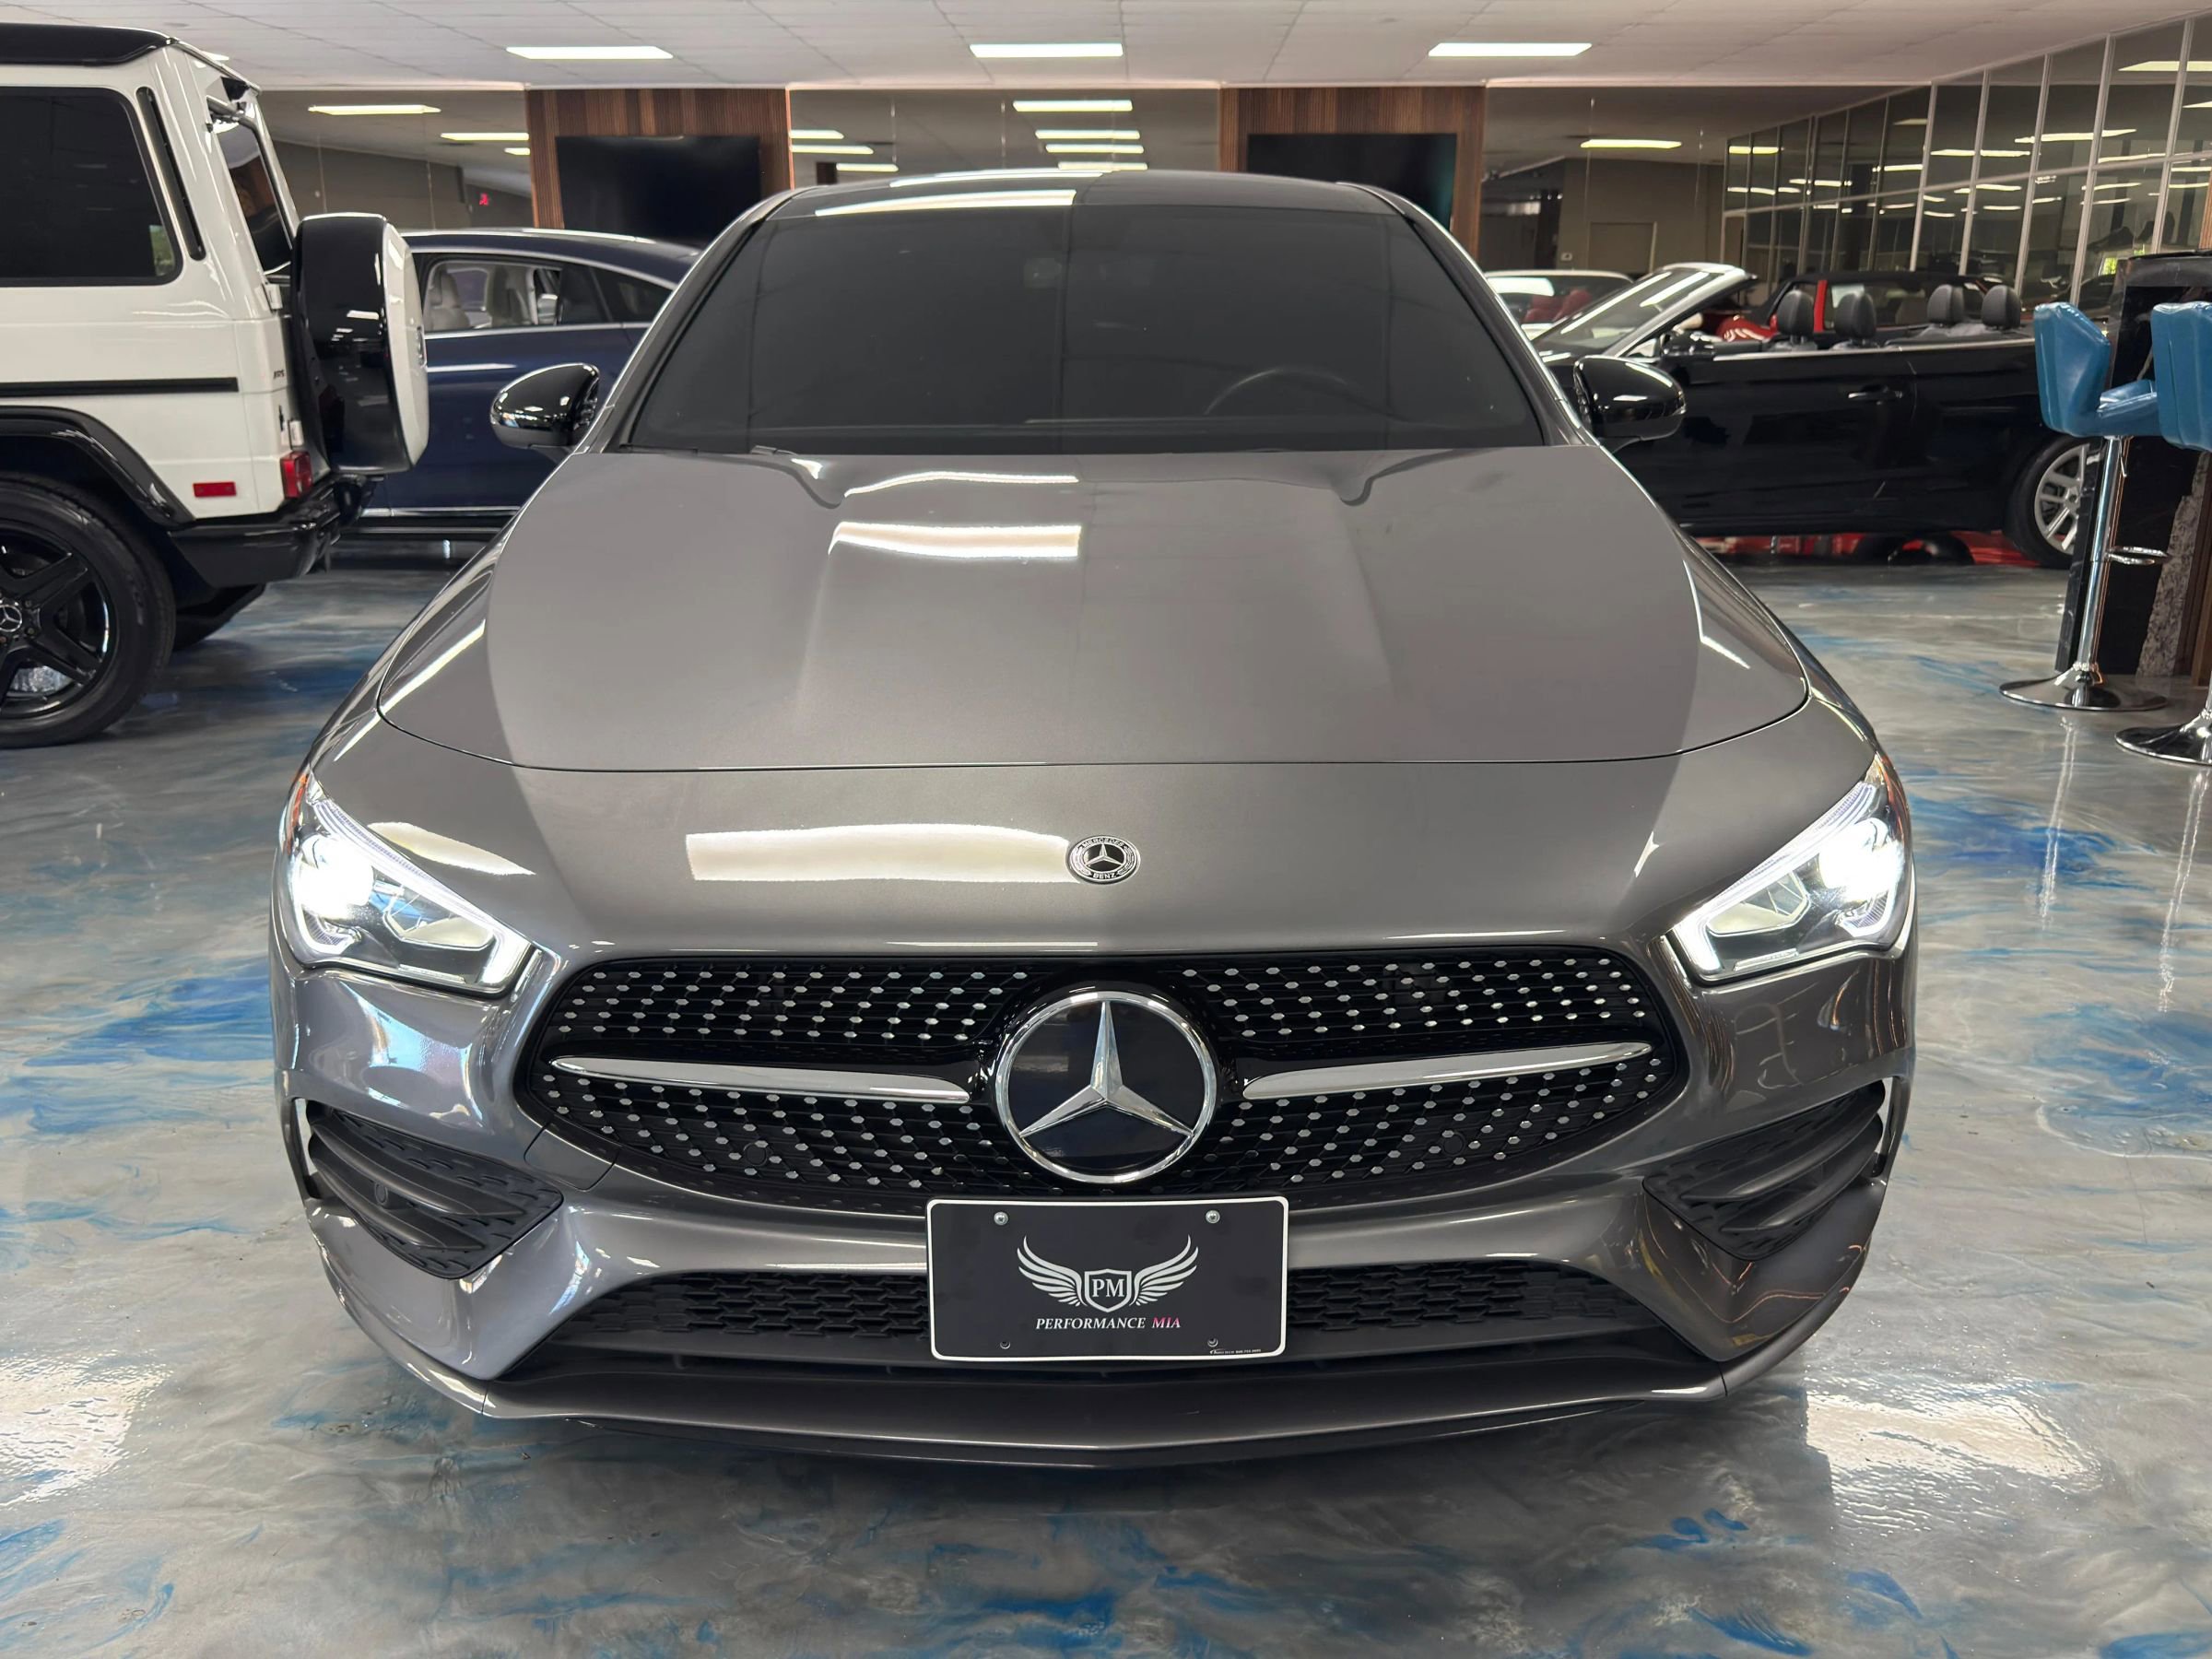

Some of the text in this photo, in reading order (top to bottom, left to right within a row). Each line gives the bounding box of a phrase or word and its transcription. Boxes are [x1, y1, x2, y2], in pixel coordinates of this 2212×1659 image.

[1091, 1278, 1125, 1298] PM
[1035, 1316, 1182, 1330] PERFORMANCE MIA
